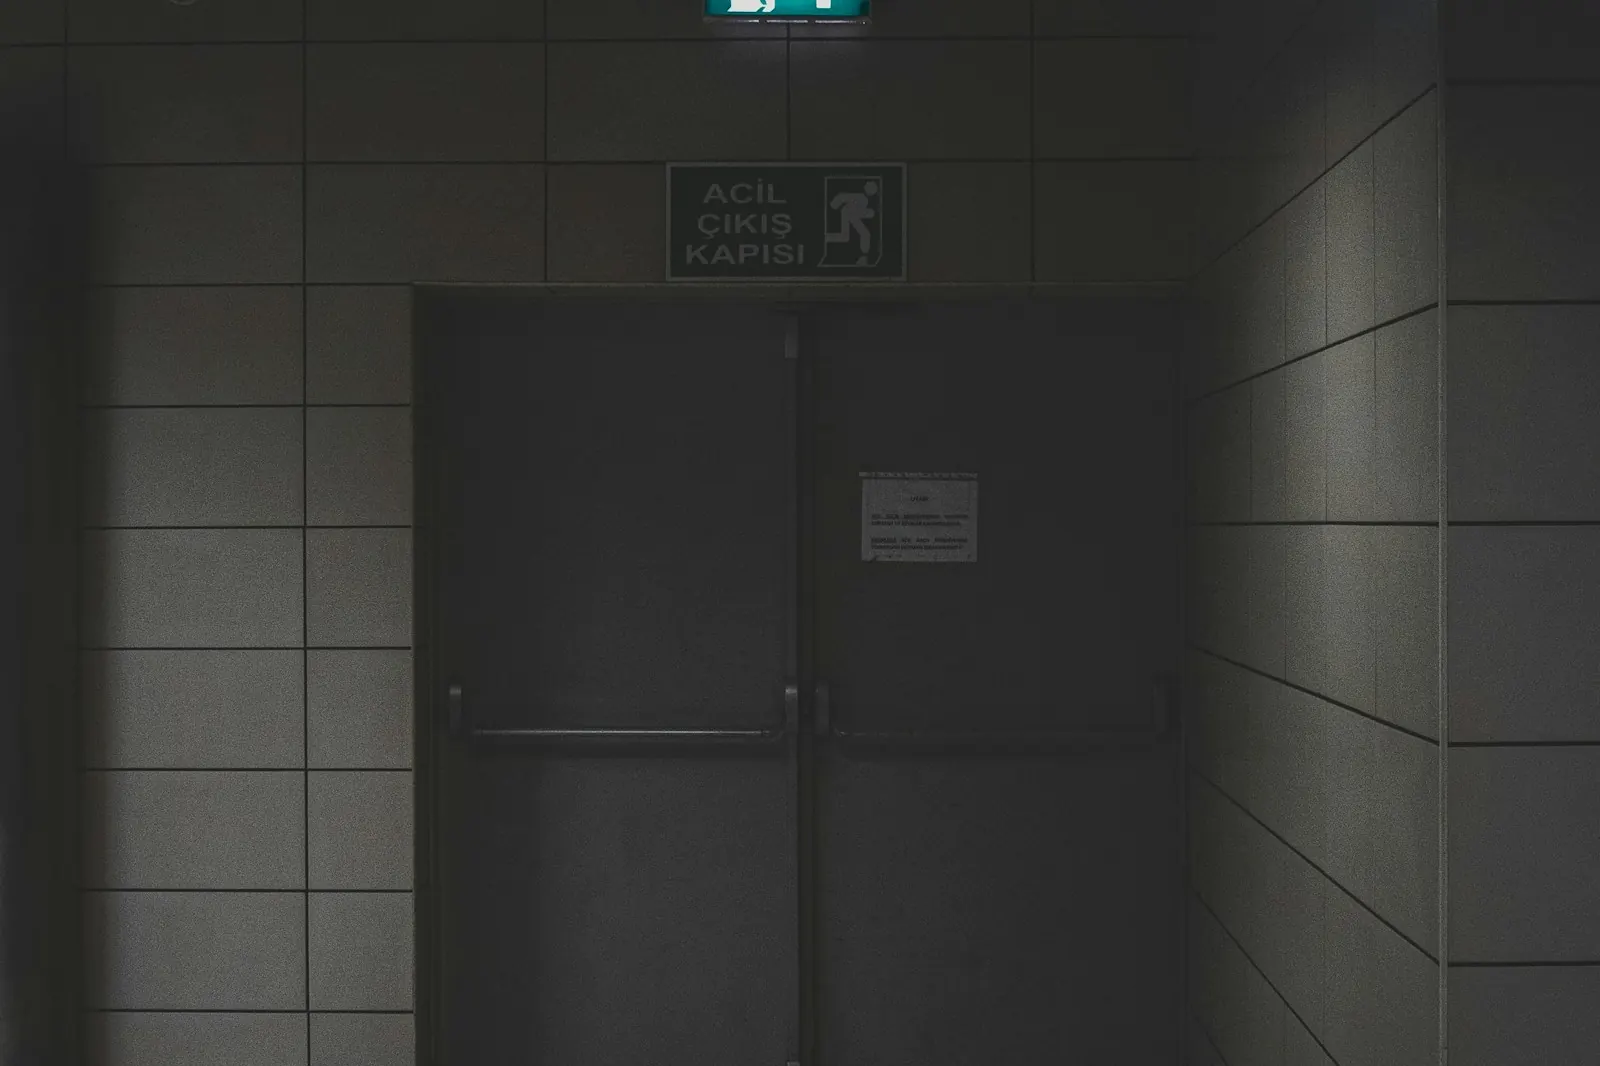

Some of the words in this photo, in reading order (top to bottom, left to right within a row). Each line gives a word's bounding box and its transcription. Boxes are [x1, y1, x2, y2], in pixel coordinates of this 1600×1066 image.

[703, 178, 787, 204] ACİL
[697, 213, 792, 239] ÇIKIŞ
[686, 244, 804, 265] KAPISI
